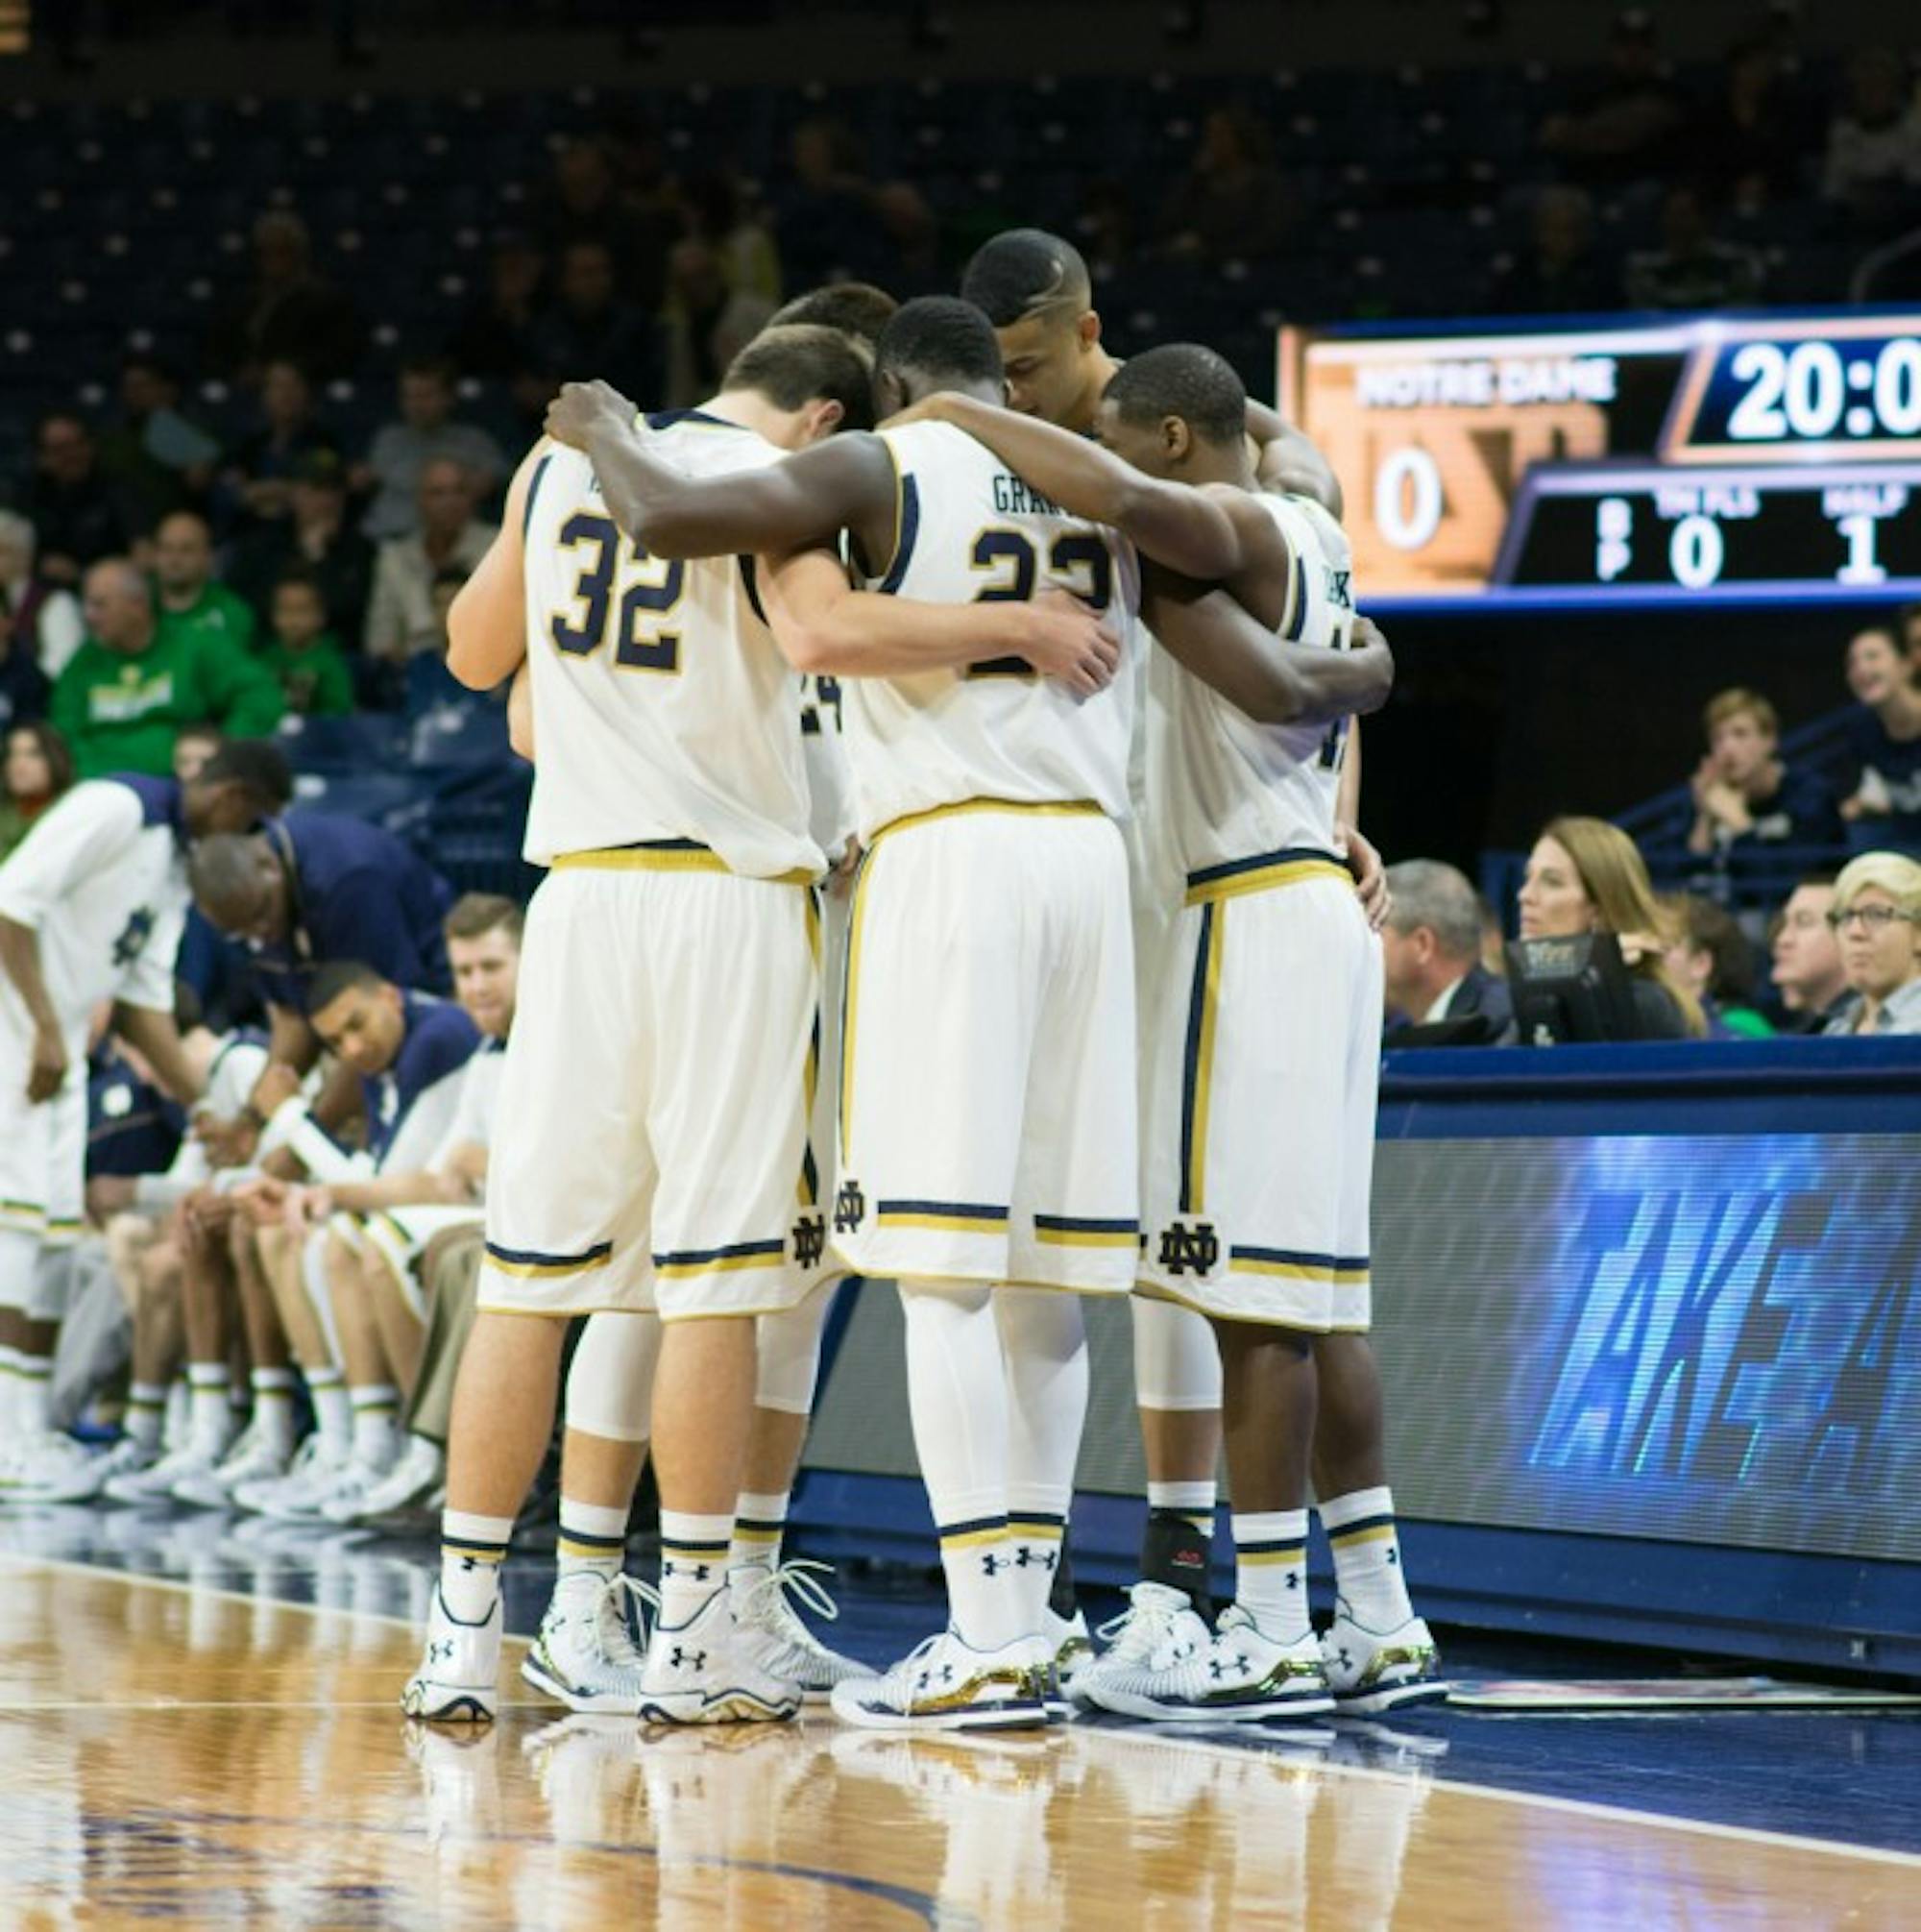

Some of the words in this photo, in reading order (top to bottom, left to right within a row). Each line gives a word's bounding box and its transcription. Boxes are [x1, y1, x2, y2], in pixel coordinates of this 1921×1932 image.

[1356, 363, 1491, 407] NOTRE
[1498, 356, 1617, 404] DAME
[993, 475, 1072, 516] GRA
[1374, 449, 1443, 550] 0
[1670, 514, 1723, 590] 0
[1836, 514, 1887, 586] 1
[550, 508, 690, 675] 32
